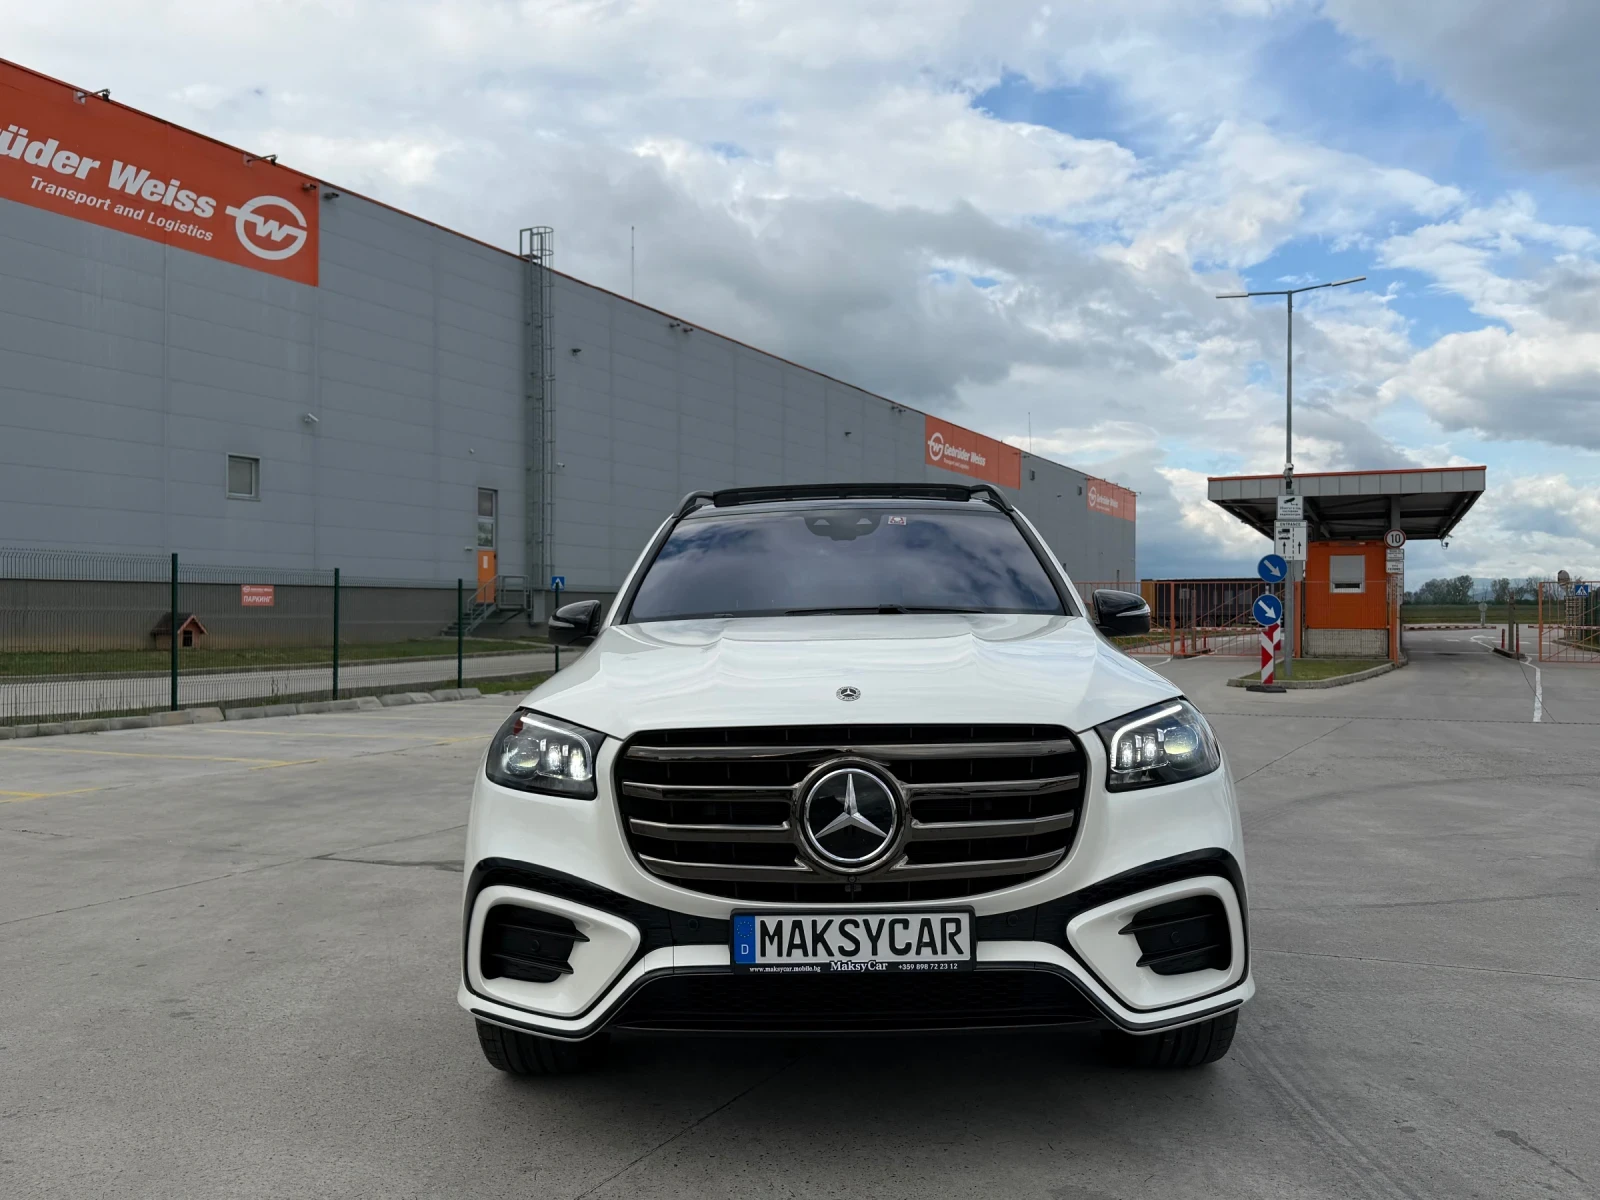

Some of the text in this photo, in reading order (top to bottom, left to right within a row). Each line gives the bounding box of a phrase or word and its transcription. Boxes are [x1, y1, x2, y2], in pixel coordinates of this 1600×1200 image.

[0, 124, 217, 219] üder Weiss
[30, 175, 214, 242] Transport and Logistics
[944, 443, 970, 462] Gebrüder
[970, 451, 986, 467] Weiss
[1390, 533, 1401, 544] 10
[243, 595, 273, 603] ПАРКИНГ
[740, 917, 964, 957] D MAKSYCAR
[749, 965, 821, 973] www.maksycar.mobile.bg
[830, 960, 888, 972] MaksyCar
